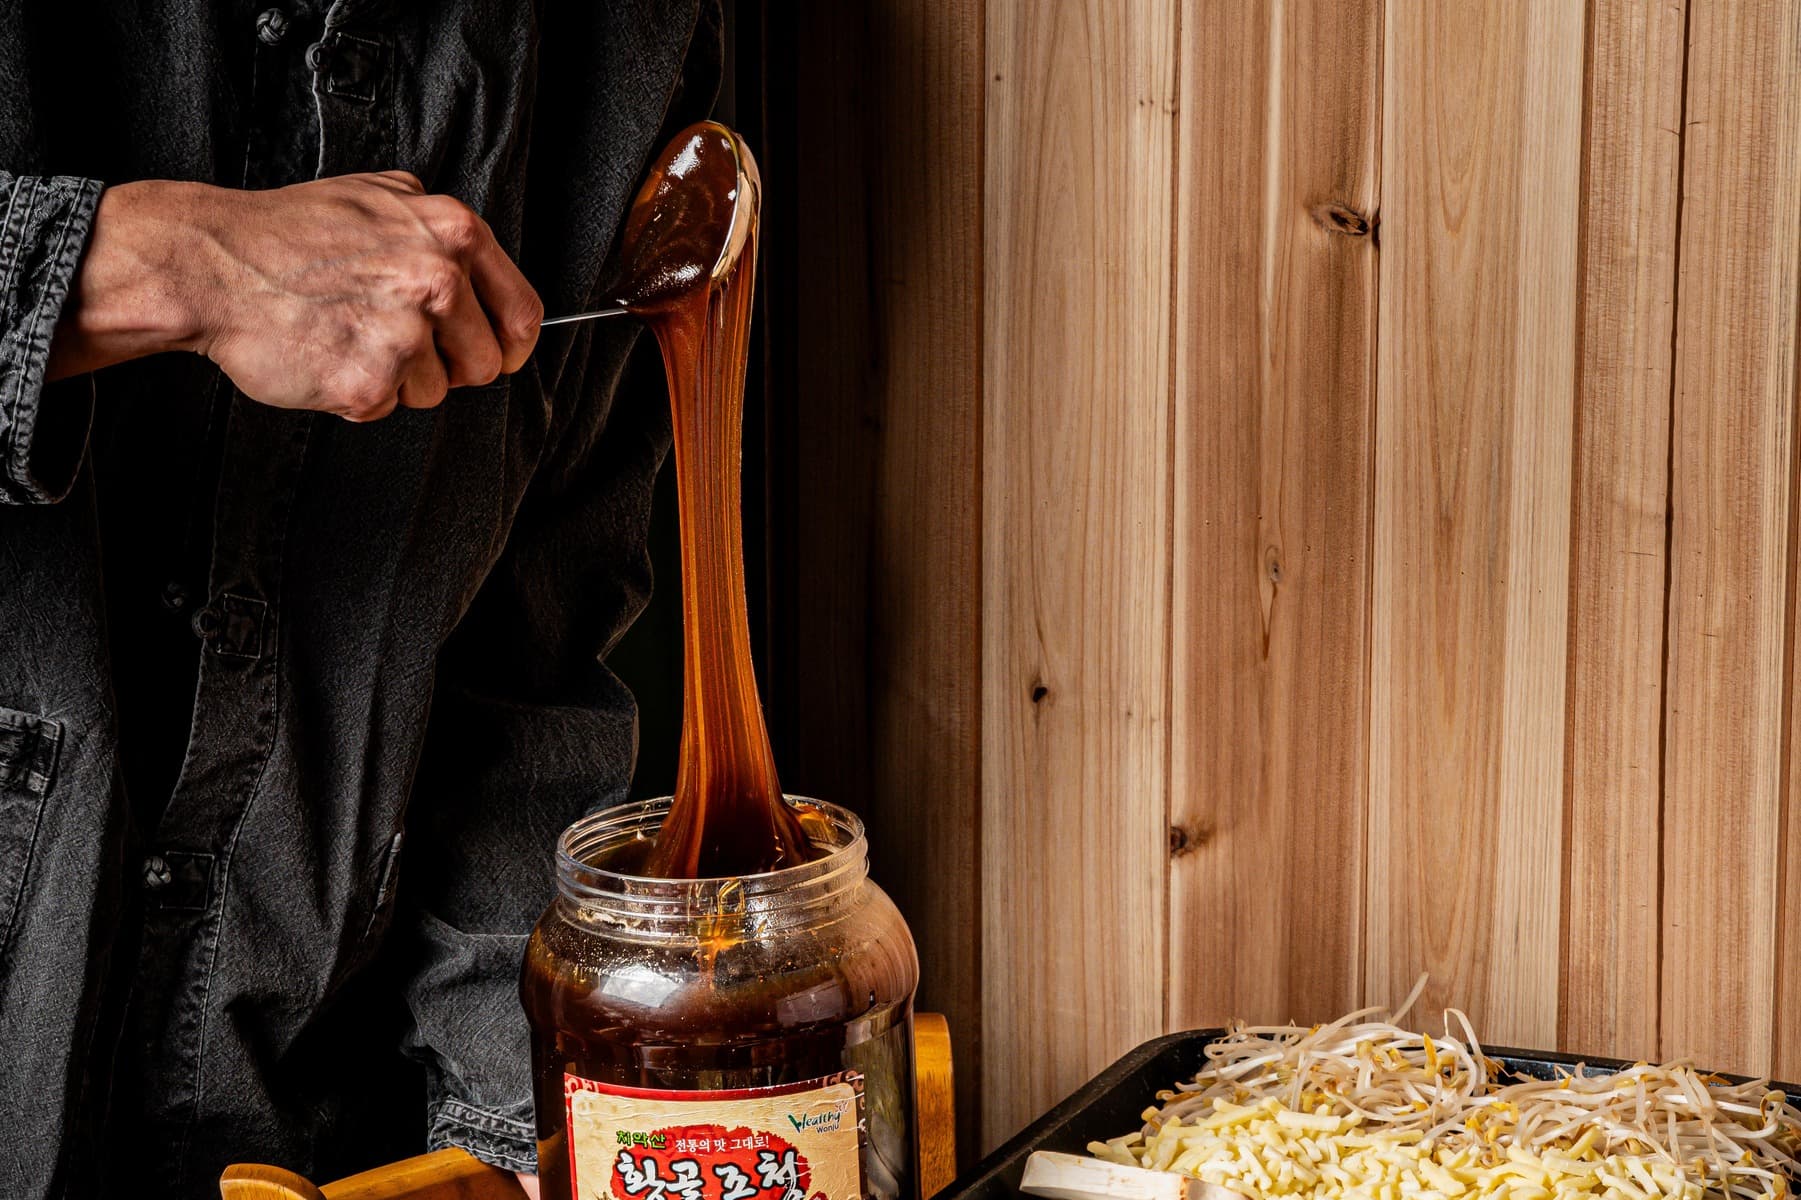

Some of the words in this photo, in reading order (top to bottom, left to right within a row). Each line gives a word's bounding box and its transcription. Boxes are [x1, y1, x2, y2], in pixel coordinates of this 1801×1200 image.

[788, 1111, 841, 1133] Healthy
[816, 1122, 839, 1134] Wonju
[616, 1130, 666, 1149] 치악산
[675, 1138, 710, 1153] 전통의
[714, 1138, 727, 1152] 맛
[730, 1135, 770, 1150] 그대로!
